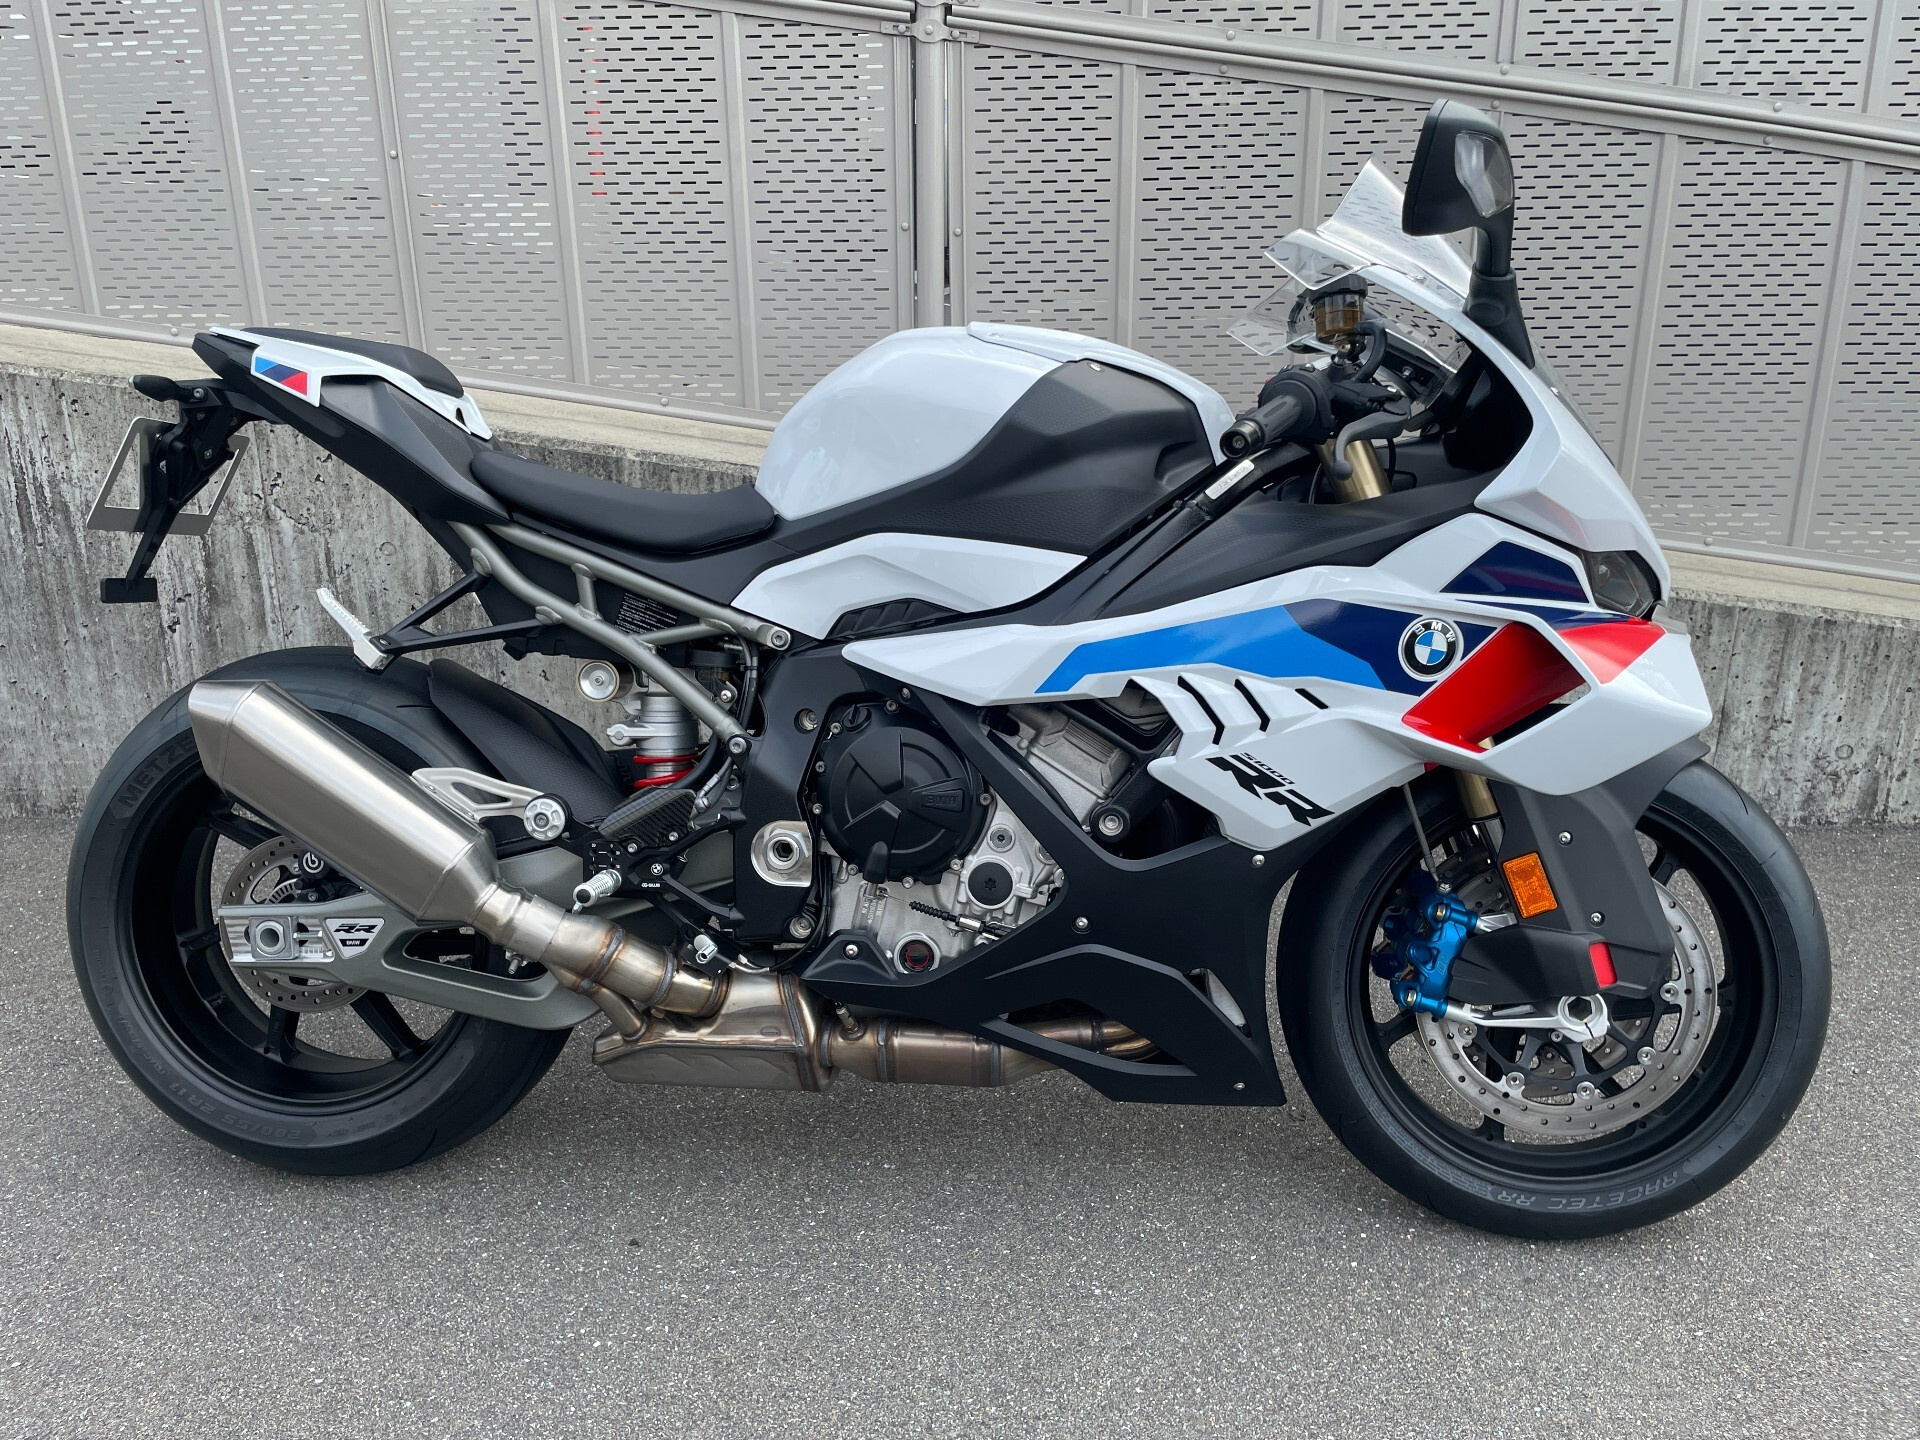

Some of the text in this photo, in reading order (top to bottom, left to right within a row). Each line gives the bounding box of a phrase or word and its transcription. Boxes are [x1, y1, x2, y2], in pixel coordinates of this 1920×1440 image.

[1413, 620, 1456, 643] BMW
[1239, 751, 1296, 785] S1000
[925, 793, 960, 807] BMW
[1204, 754, 1335, 827] RR
[333, 924, 378, 934] RR
[1496, 1170, 1678, 1210] RACETEC RR
